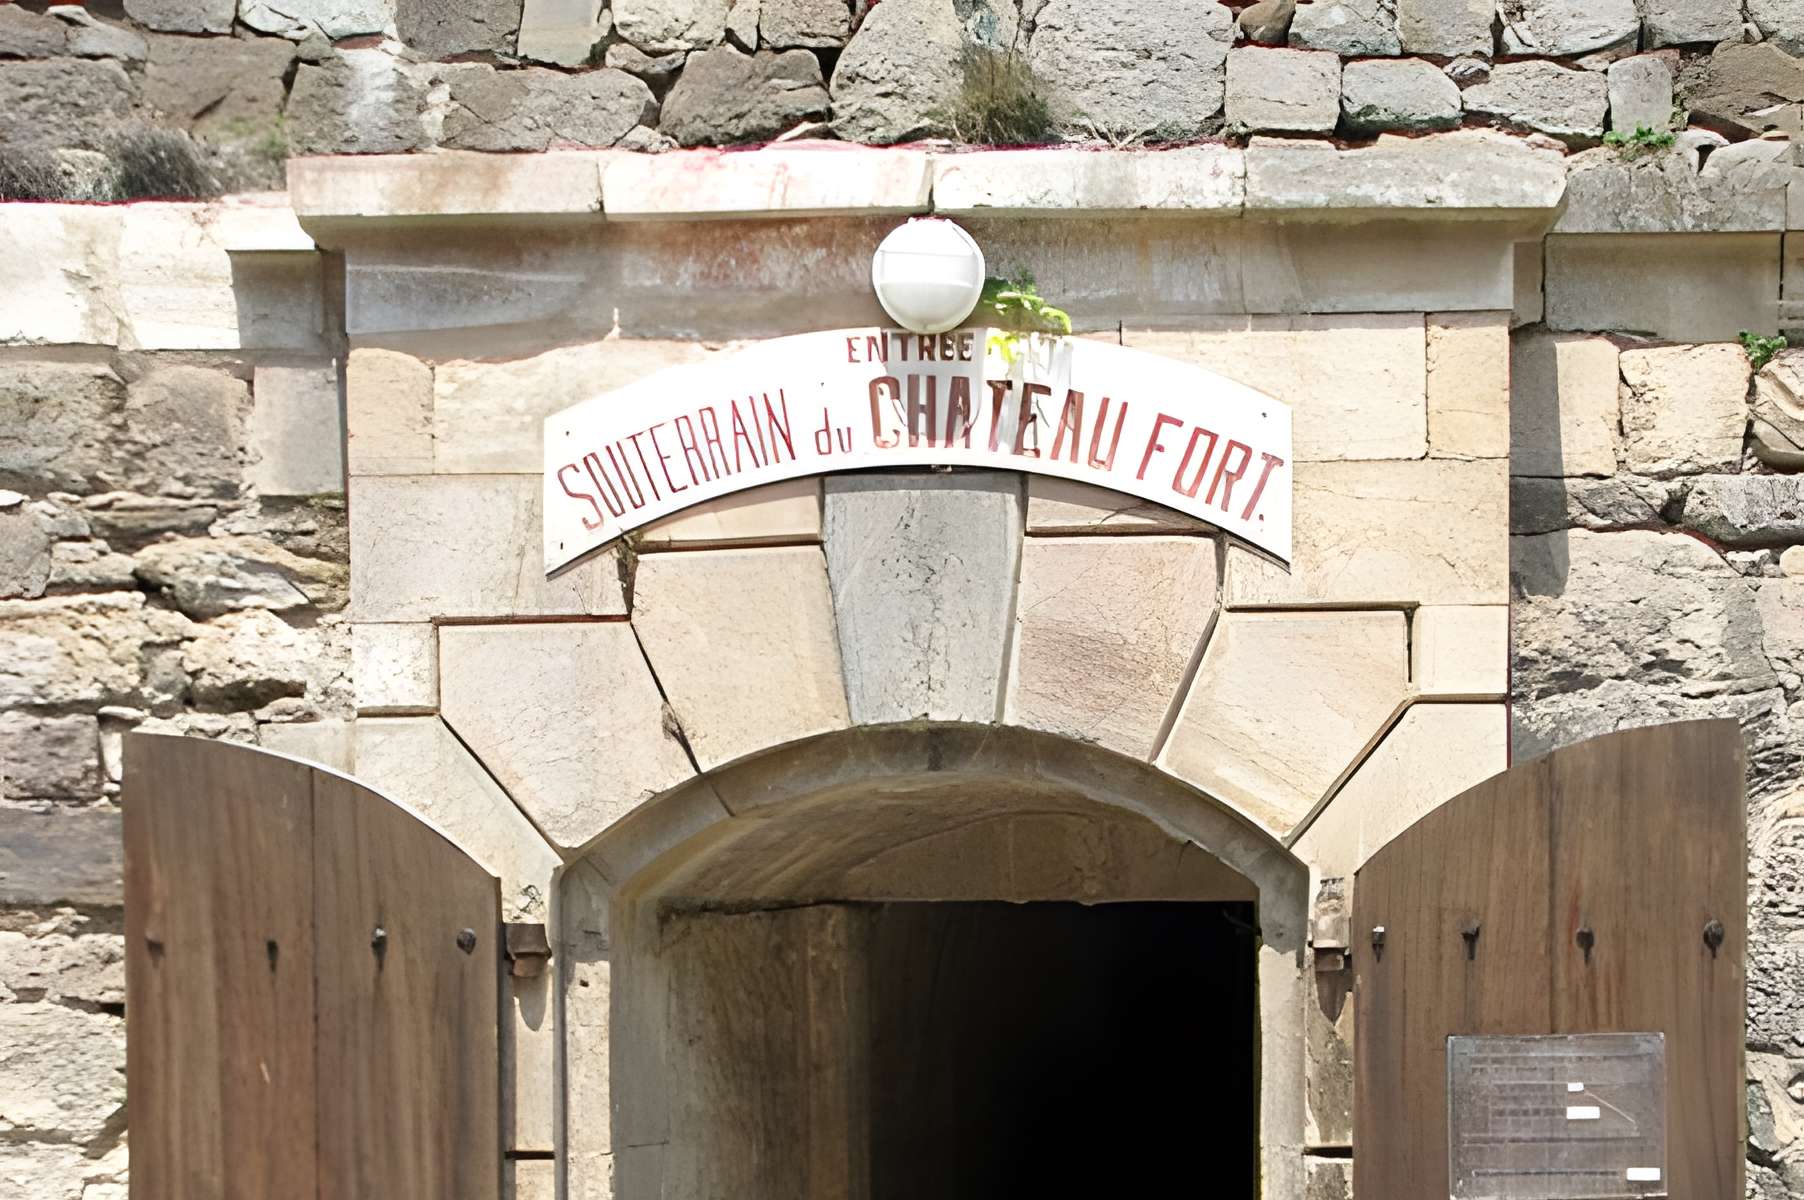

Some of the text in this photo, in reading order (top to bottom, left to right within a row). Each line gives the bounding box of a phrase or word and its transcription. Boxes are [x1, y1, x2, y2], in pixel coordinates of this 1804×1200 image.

[557, 388, 796, 531] SOUTERRAIN
[815, 407, 852, 455] du
[869, 374, 1128, 472] CHATEAU
